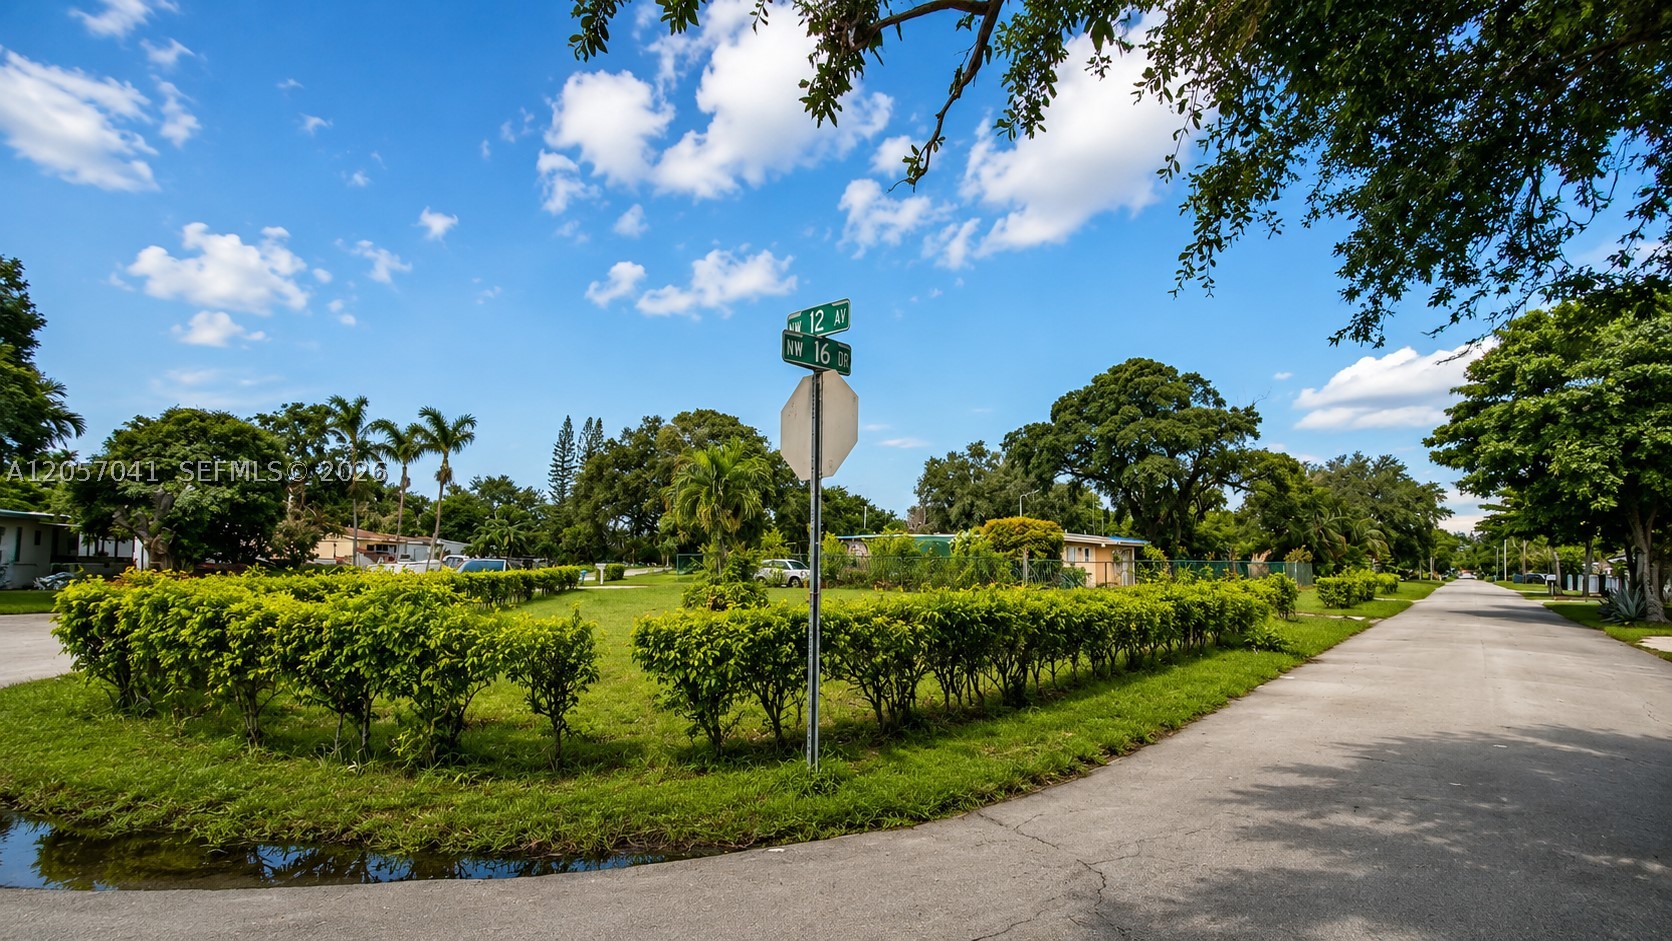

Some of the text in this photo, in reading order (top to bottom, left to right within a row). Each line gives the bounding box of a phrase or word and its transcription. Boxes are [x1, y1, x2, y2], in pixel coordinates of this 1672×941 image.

[810, 309, 824, 334] 12
[787, 339, 849, 368] NW 16 DR
